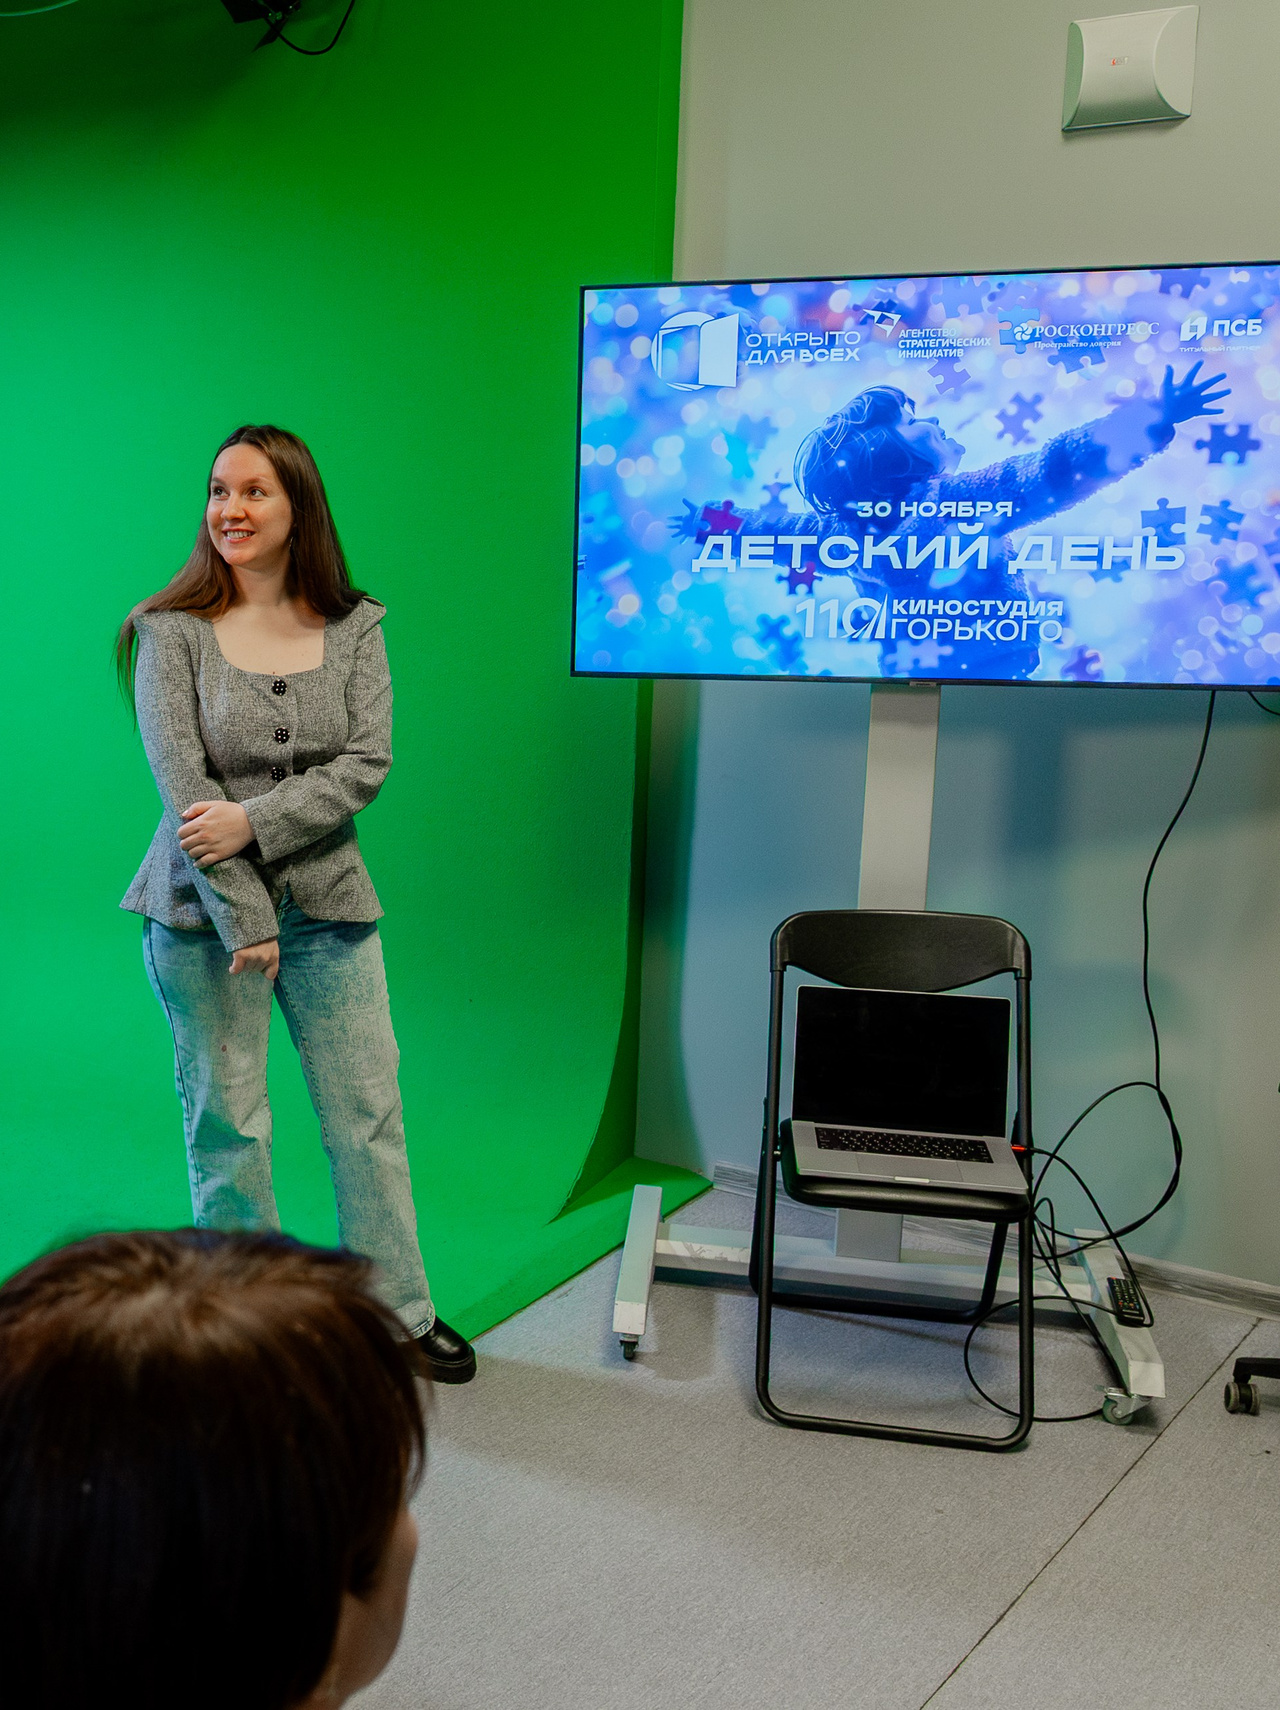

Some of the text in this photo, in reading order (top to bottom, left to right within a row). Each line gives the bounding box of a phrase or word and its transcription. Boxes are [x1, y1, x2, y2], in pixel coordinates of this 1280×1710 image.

[898, 328, 957, 338] АГЕНТСТВО
[1034, 322, 1161, 338] РОСКОНГРЕСС
[1212, 318, 1263, 337] ПСБ
[745, 331, 861, 348] ОТКРЫТО
[898, 337, 992, 349] СТРАТЕГИЧЕСКИХ
[1034, 341, 1089, 350] Пространство
[745, 348, 861, 366] ДЛЯ ВСЕХ
[898, 349, 965, 360] ИНИЦИАТИВ
[857, 501, 1013, 518] 30 НОЯБРЯ
[691, 522, 1186, 575] ДЕТСКИЙ ДЕНЬ
[892, 599, 1064, 619] КИНОСТУДИЯ
[891, 618, 1063, 642] ГОРЬКОГО
